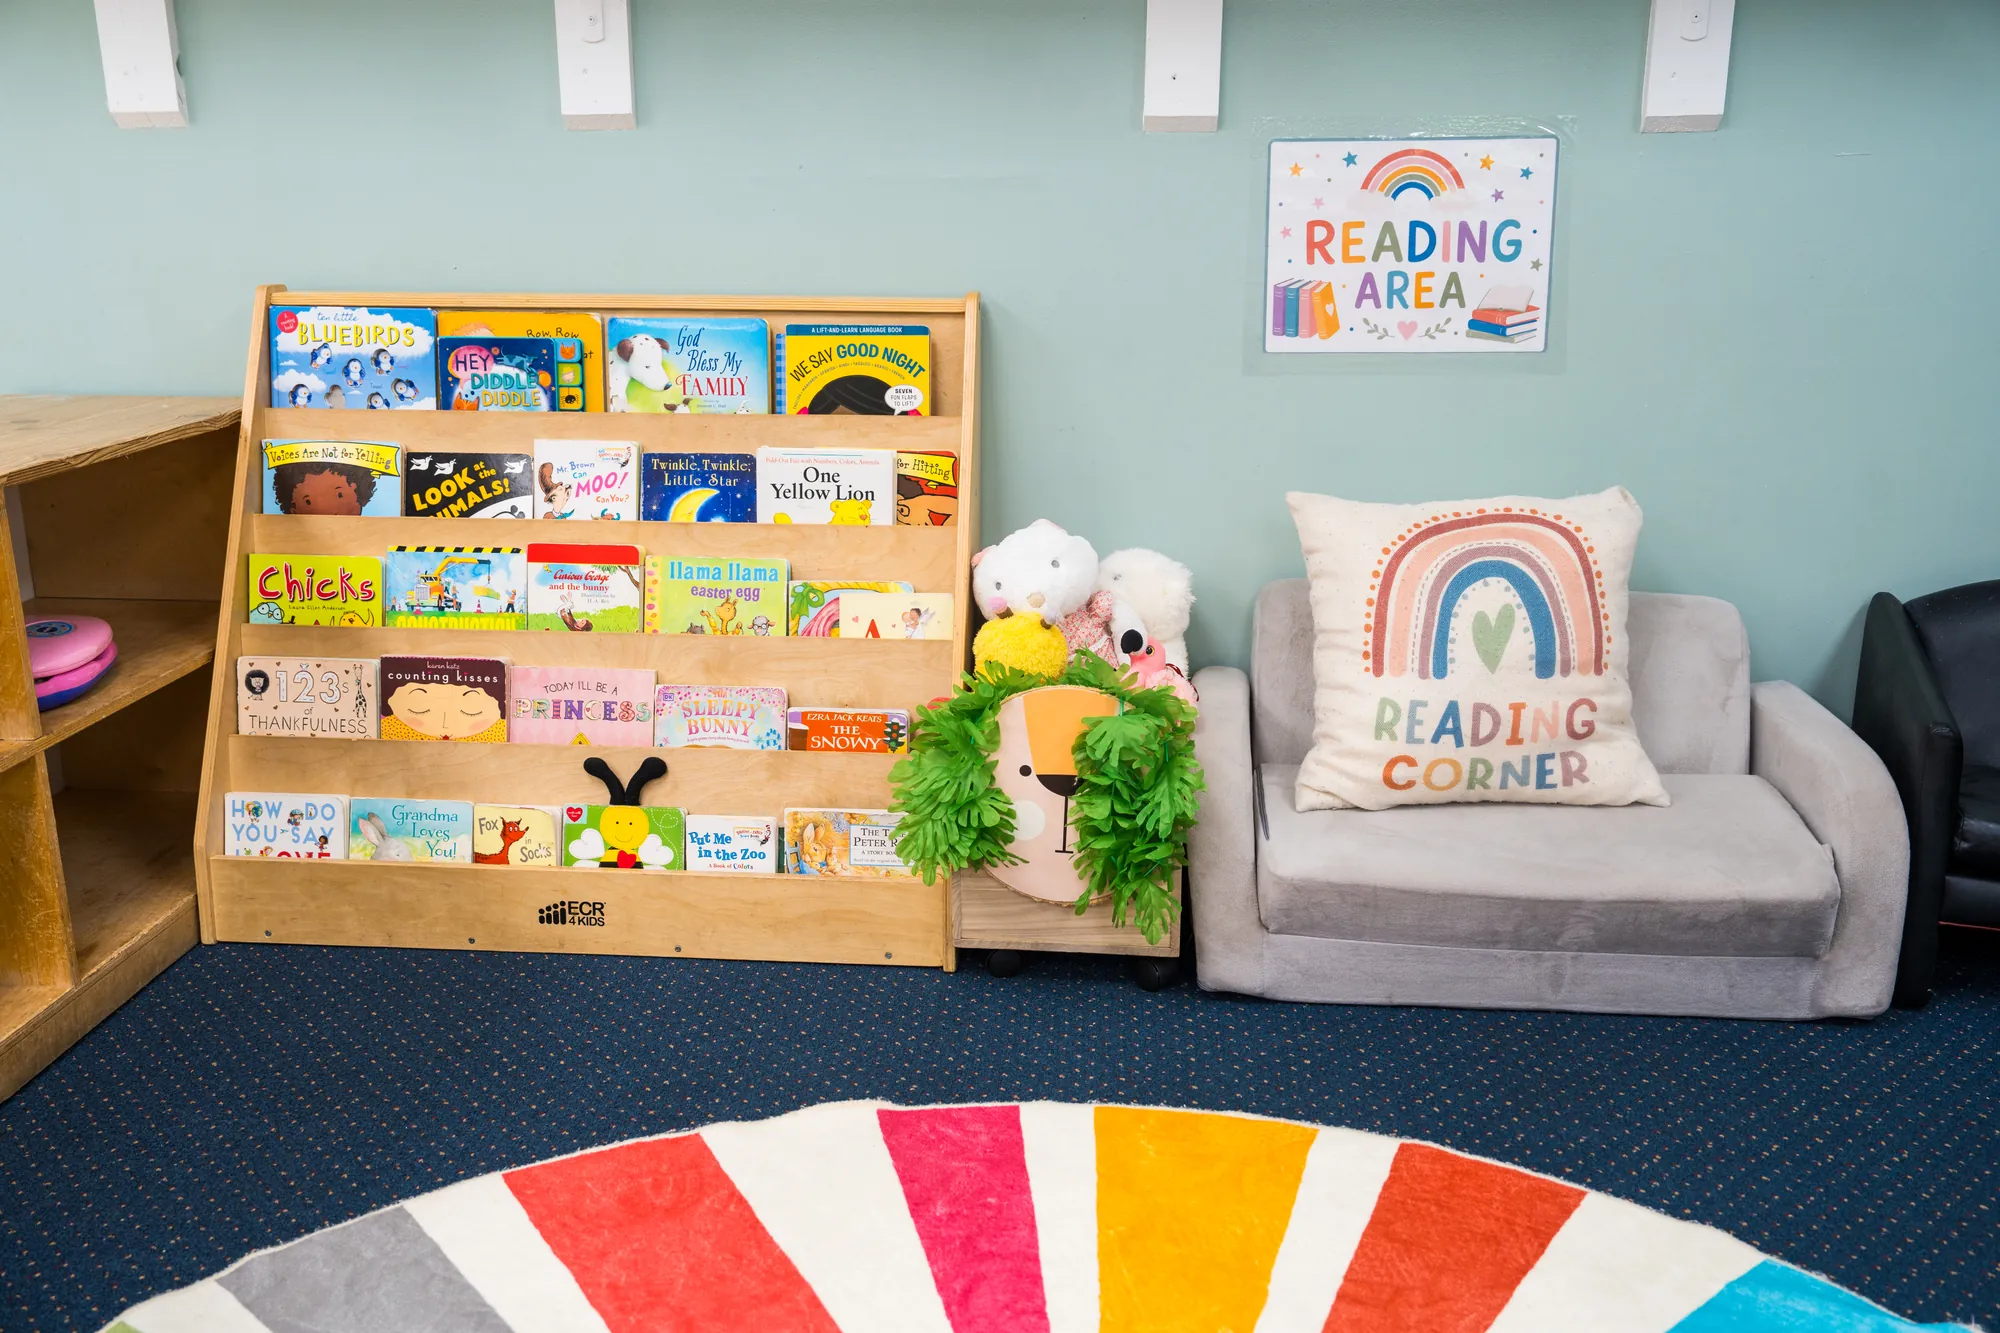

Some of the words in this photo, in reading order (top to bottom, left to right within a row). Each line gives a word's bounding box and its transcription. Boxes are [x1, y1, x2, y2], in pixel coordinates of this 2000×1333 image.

[1306, 219, 1523, 265] READING
[1354, 270, 1466, 309] AREA
[317, 312, 330, 320] ten
[334, 313, 359, 322] little
[298, 322, 415, 348] BLUEBIRDS
[526, 329, 552, 338] Row,
[556, 327, 579, 338] Row
[676, 324, 705, 355] God
[455, 353, 491, 372] HEY
[687, 350, 719, 372] Bless
[720, 352, 742, 376] My
[790, 360, 812, 382] WE
[809, 347, 832, 368] SAY
[836, 343, 879, 359] GOOD
[882, 347, 926, 378] NIGHT
[471, 373, 538, 390] DIDDLE
[676, 374, 748, 396] FAMILY
[481, 390, 542, 407] DIDDLE
[270, 450, 299, 463] Voices
[302, 448, 319, 458] Are
[322, 446, 338, 458] Not
[341, 449, 354, 458] for
[355, 447, 392, 470] Yelling
[569, 461, 595, 471] Brown
[652, 458, 700, 471] Twinkle,
[803, 466, 840, 483] One
[897, 458, 909, 468] for
[913, 459, 950, 480] Hitting
[412, 467, 476, 511] LOOK
[473, 460, 485, 471] at
[479, 467, 496, 479] the
[575, 472, 629, 498] MOO!
[664, 473, 701, 486] Little
[709, 473, 738, 486] Star
[430, 478, 510, 518] NIMALS!
[596, 495, 610, 503] Can
[610, 494, 629, 503] You?
[770, 483, 830, 500] Yellow
[835, 485, 875, 501] Lion
[554, 569, 583, 580] Curious
[584, 570, 610, 585] George
[669, 561, 722, 580] llama
[728, 562, 779, 582] llama
[258, 562, 375, 602] Chicks
[583, 583, 609, 593] bunny
[691, 586, 732, 599] easter
[736, 587, 760, 602] egg
[427, 661, 445, 669] karen
[446, 661, 460, 670] katz
[388, 671, 449, 684] counting
[456, 670, 498, 683] kisses
[543, 682, 574, 694] TODAY
[578, 681, 592, 691] I'LL
[596, 682, 607, 693] BE
[612, 686, 618, 696] A
[304, 707, 314, 715] of
[513, 699, 652, 722] PRINCESS
[681, 699, 761, 720] SLEEPY
[807, 713, 830, 721] EZRA
[856, 715, 882, 723] KEATS
[249, 715, 367, 734] THANKFULNESS
[687, 718, 754, 737] BUNNY
[830, 725, 860, 735] THE
[1373, 696, 1598, 749] READING
[810, 736, 883, 750] SNOWY
[1381, 750, 1590, 791] CORNER
[305, 802, 335, 821] DO
[391, 804, 458, 825] Grandma
[232, 823, 277, 842] YOU
[292, 827, 334, 844] SAY
[412, 822, 450, 841] Loves
[478, 817, 499, 834] Fox
[861, 828, 879, 836] THE
[689, 832, 711, 845] Put
[713, 833, 732, 845] Me
[854, 837, 886, 847] PETER
[426, 840, 457, 859] You!
[698, 847, 712, 858] in
[715, 849, 737, 861] the
[740, 849, 766, 860] Zoo
[568, 901, 604, 916] ECR
